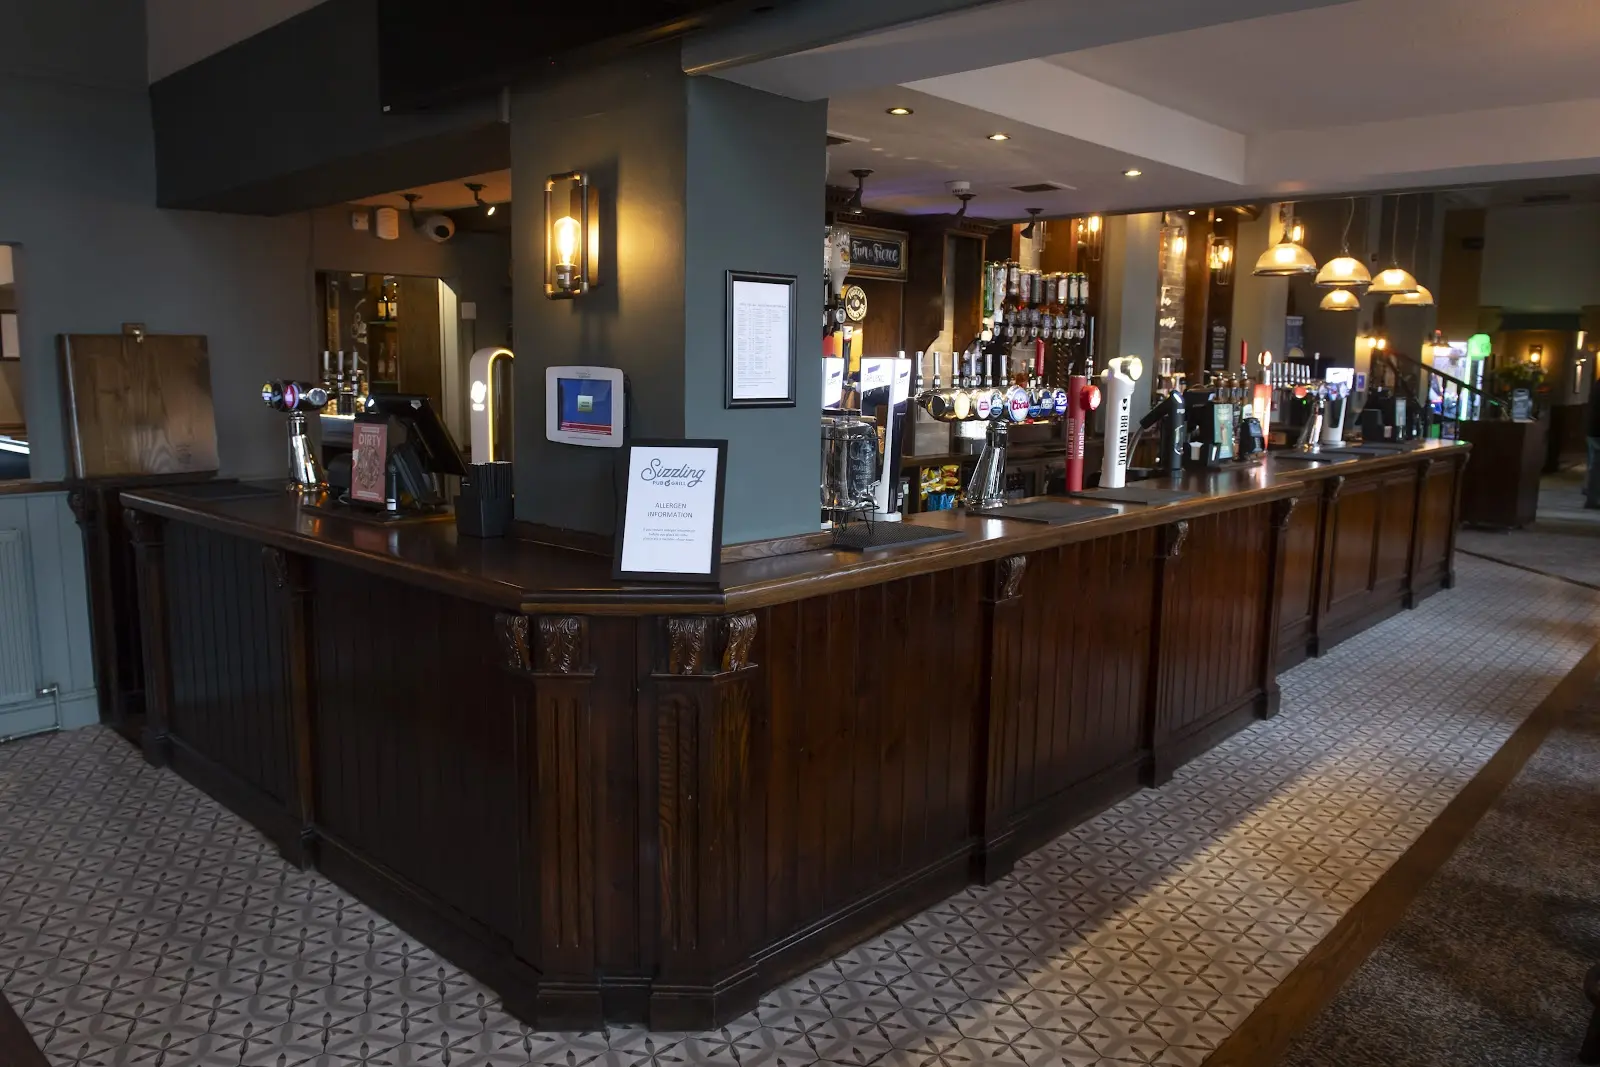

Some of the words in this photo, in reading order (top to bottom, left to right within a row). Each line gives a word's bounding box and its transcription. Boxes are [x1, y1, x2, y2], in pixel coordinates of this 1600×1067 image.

[852, 240, 869, 261] Fun
[873, 243, 898, 263] Fierce
[1011, 399, 1029, 410] Coors
[358, 433, 381, 448] DIRTY
[1118, 415, 1128, 466] BREWDOG
[640, 458, 706, 487] Sizzling
